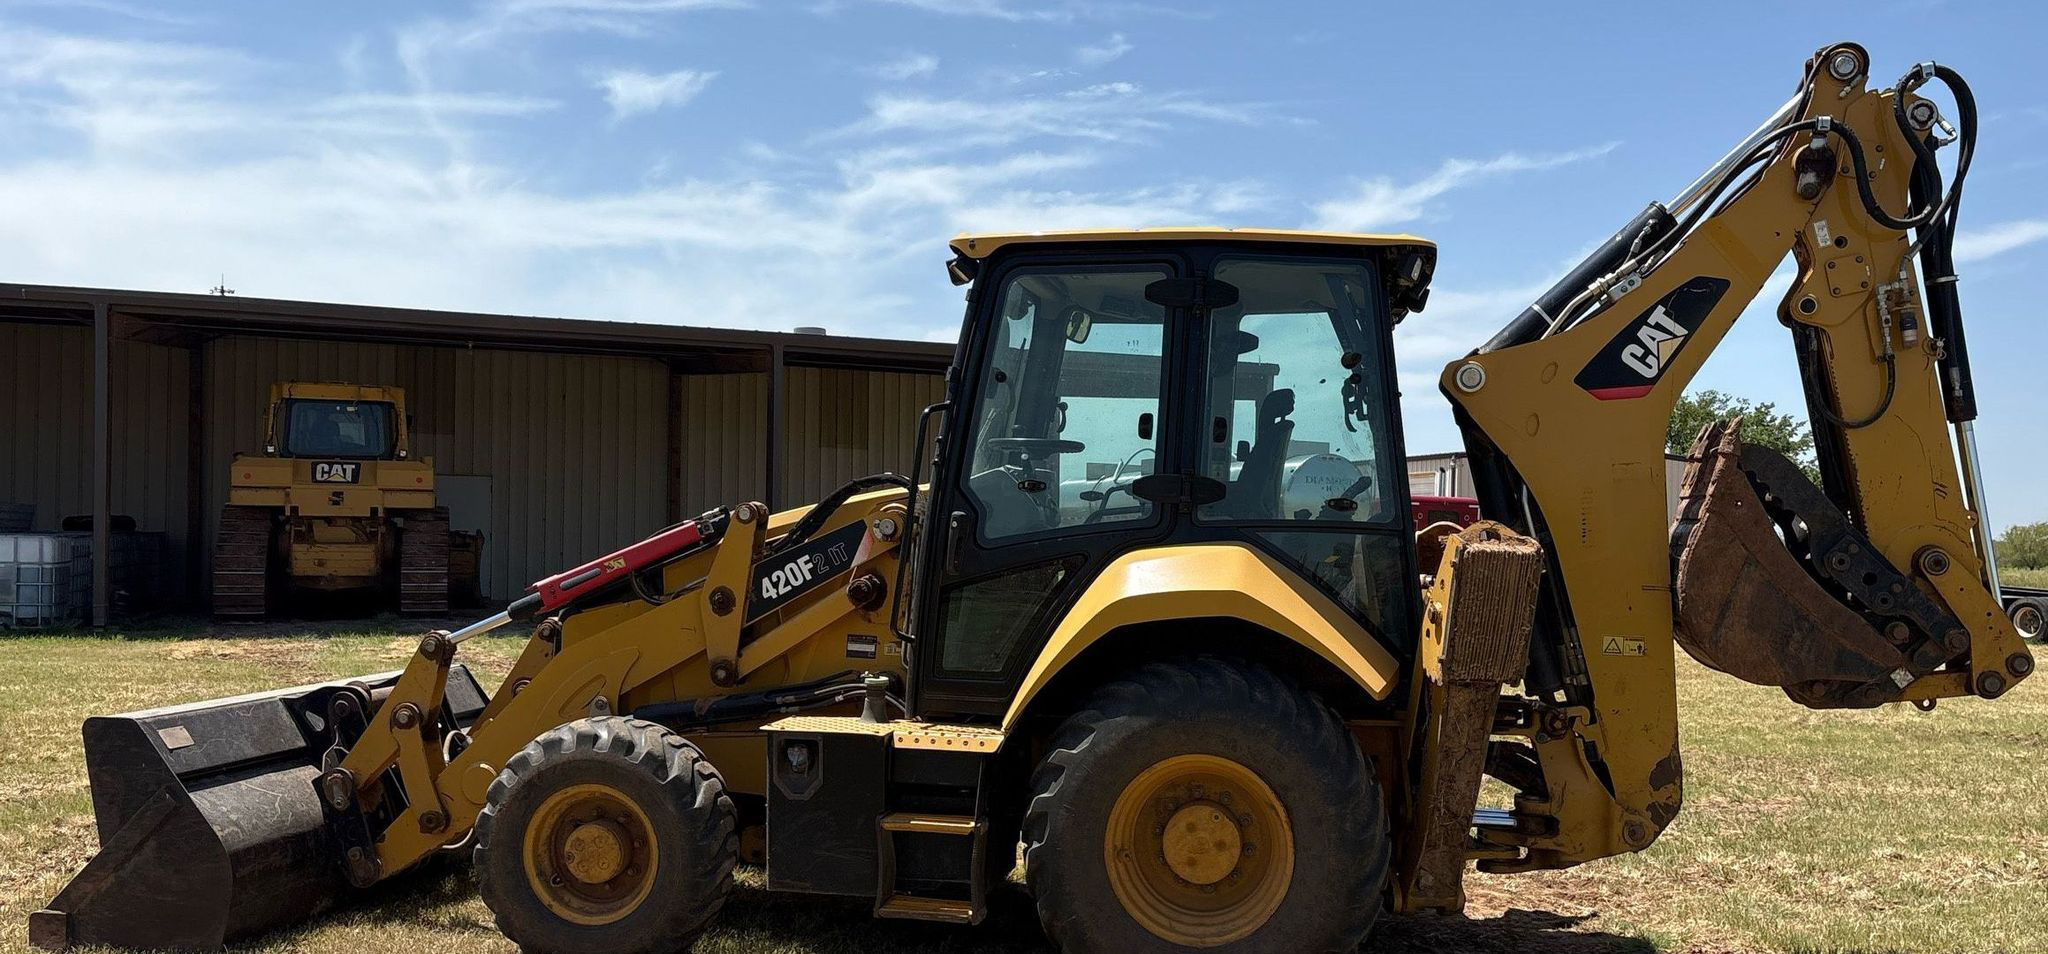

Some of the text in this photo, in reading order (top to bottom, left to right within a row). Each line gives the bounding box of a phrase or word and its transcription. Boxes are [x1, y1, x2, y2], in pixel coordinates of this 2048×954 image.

[1621, 305, 1688, 379] CAT
[315, 463, 356, 482] CAT
[829, 542, 850, 565] IT
